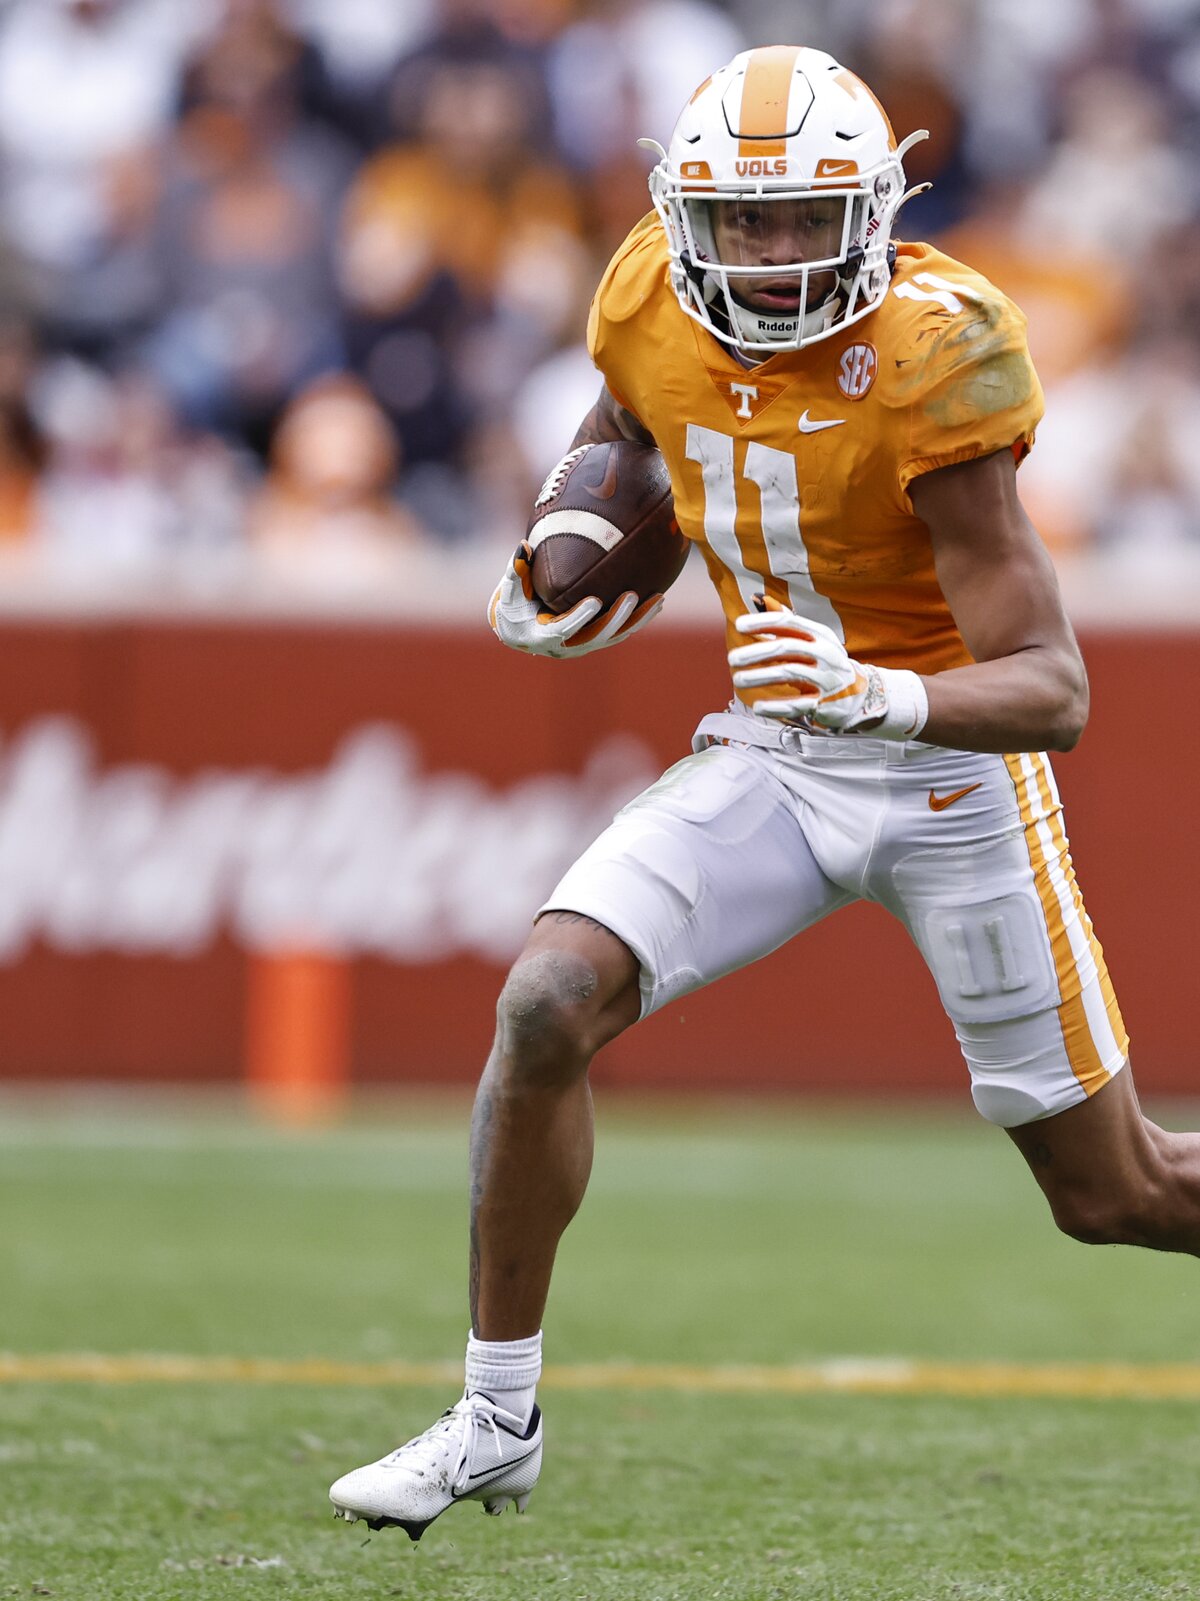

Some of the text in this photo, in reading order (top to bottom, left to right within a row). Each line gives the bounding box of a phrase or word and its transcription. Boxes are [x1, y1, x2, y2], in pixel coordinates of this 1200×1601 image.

[735, 159, 787, 177] VOLS
[838, 345, 875, 395] SEC
[731, 382, 759, 418] T
[685, 423, 846, 645] 11
